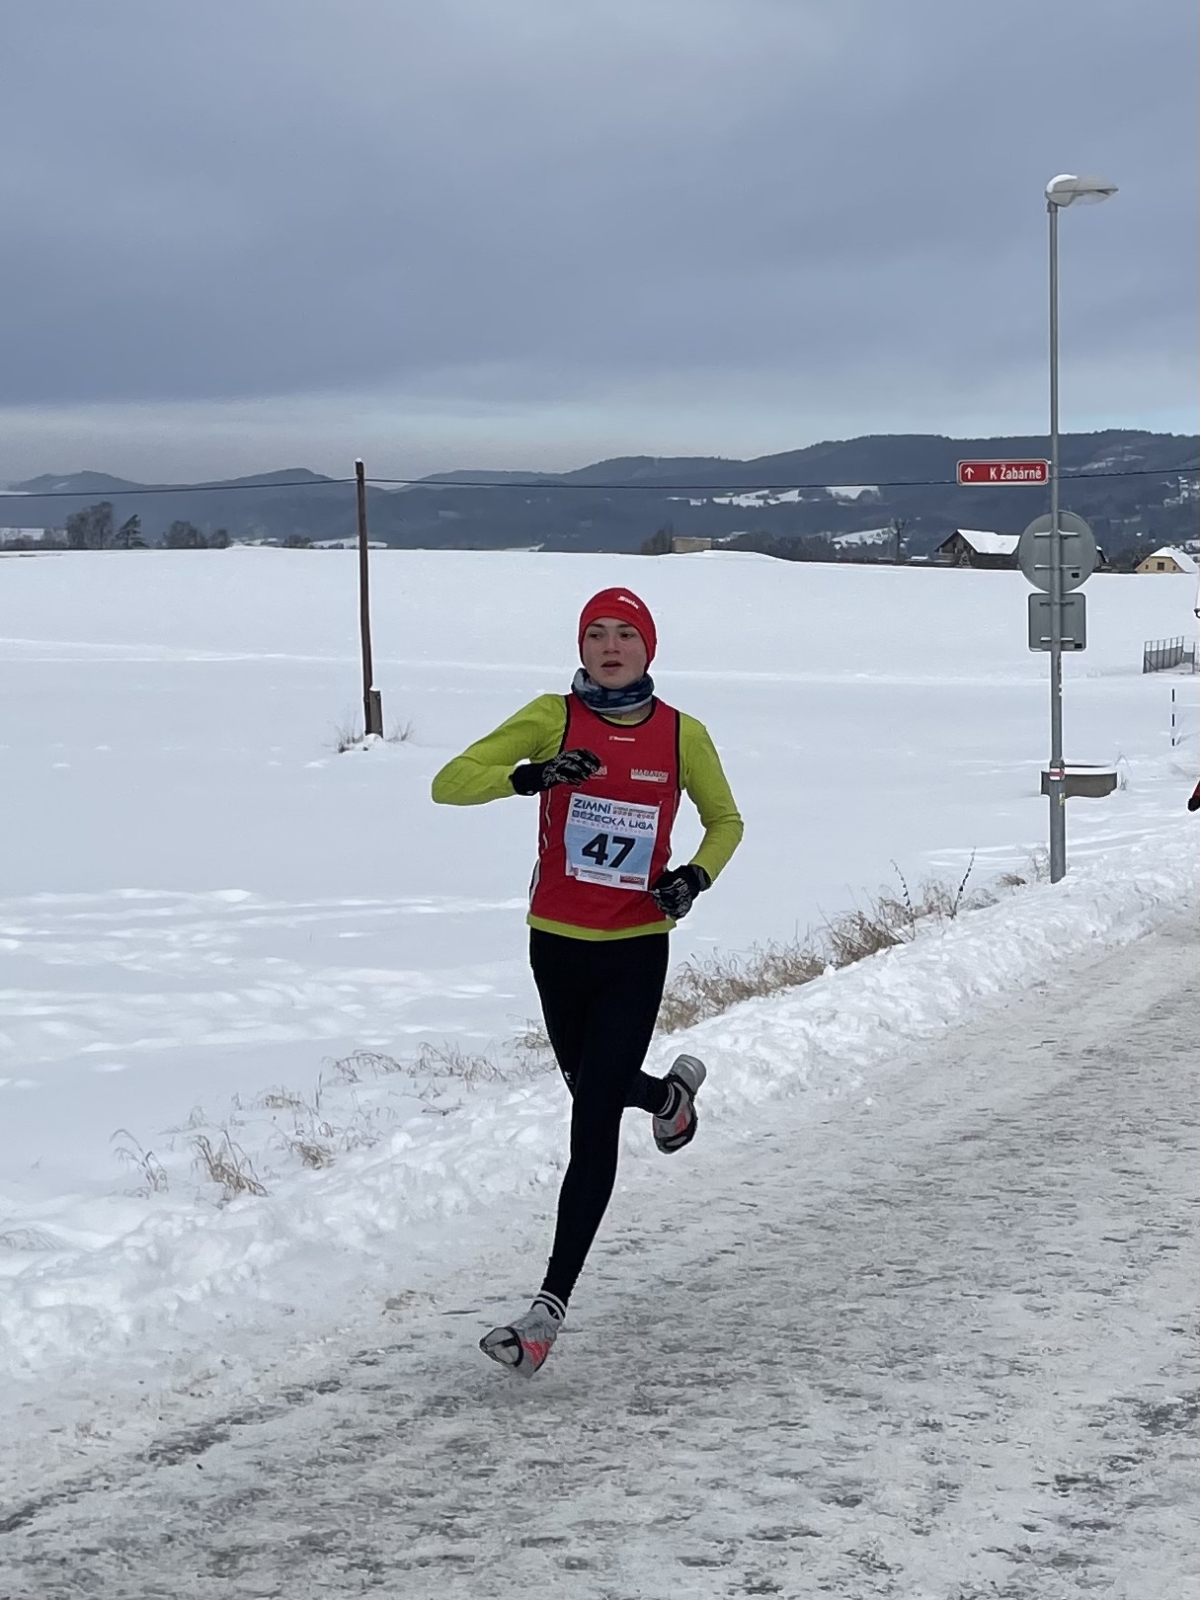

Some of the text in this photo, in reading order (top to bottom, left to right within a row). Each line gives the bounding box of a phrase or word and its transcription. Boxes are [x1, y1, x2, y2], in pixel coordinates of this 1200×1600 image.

[989, 464, 1042, 480] K Žabárně
[573, 798, 612, 815] ZIMNÍ
[628, 820, 654, 831] LIGA
[581, 832, 636, 869] 47
